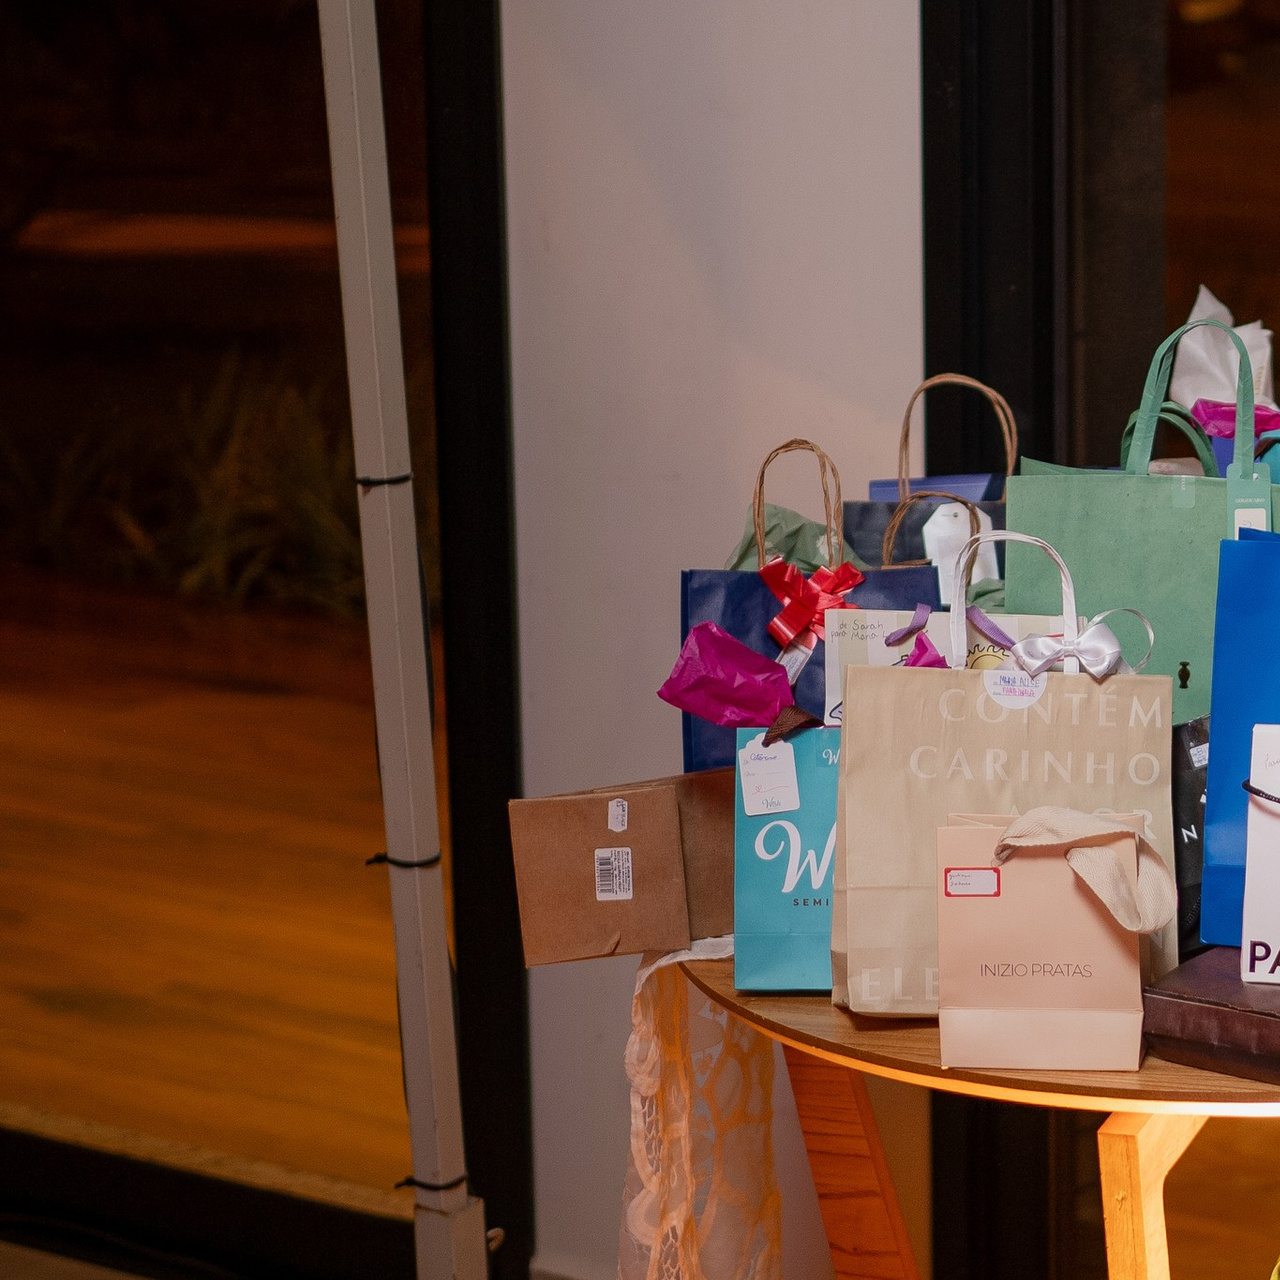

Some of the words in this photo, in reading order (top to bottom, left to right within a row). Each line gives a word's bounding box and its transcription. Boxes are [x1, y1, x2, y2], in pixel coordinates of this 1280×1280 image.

[852, 619, 884, 631] Sarah
[938, 684, 1162, 728] CONTÉM
[909, 745, 1161, 785] CARINHO
[980, 963, 1028, 977] INIZIO
[1031, 963, 1093, 978] PRATAS
